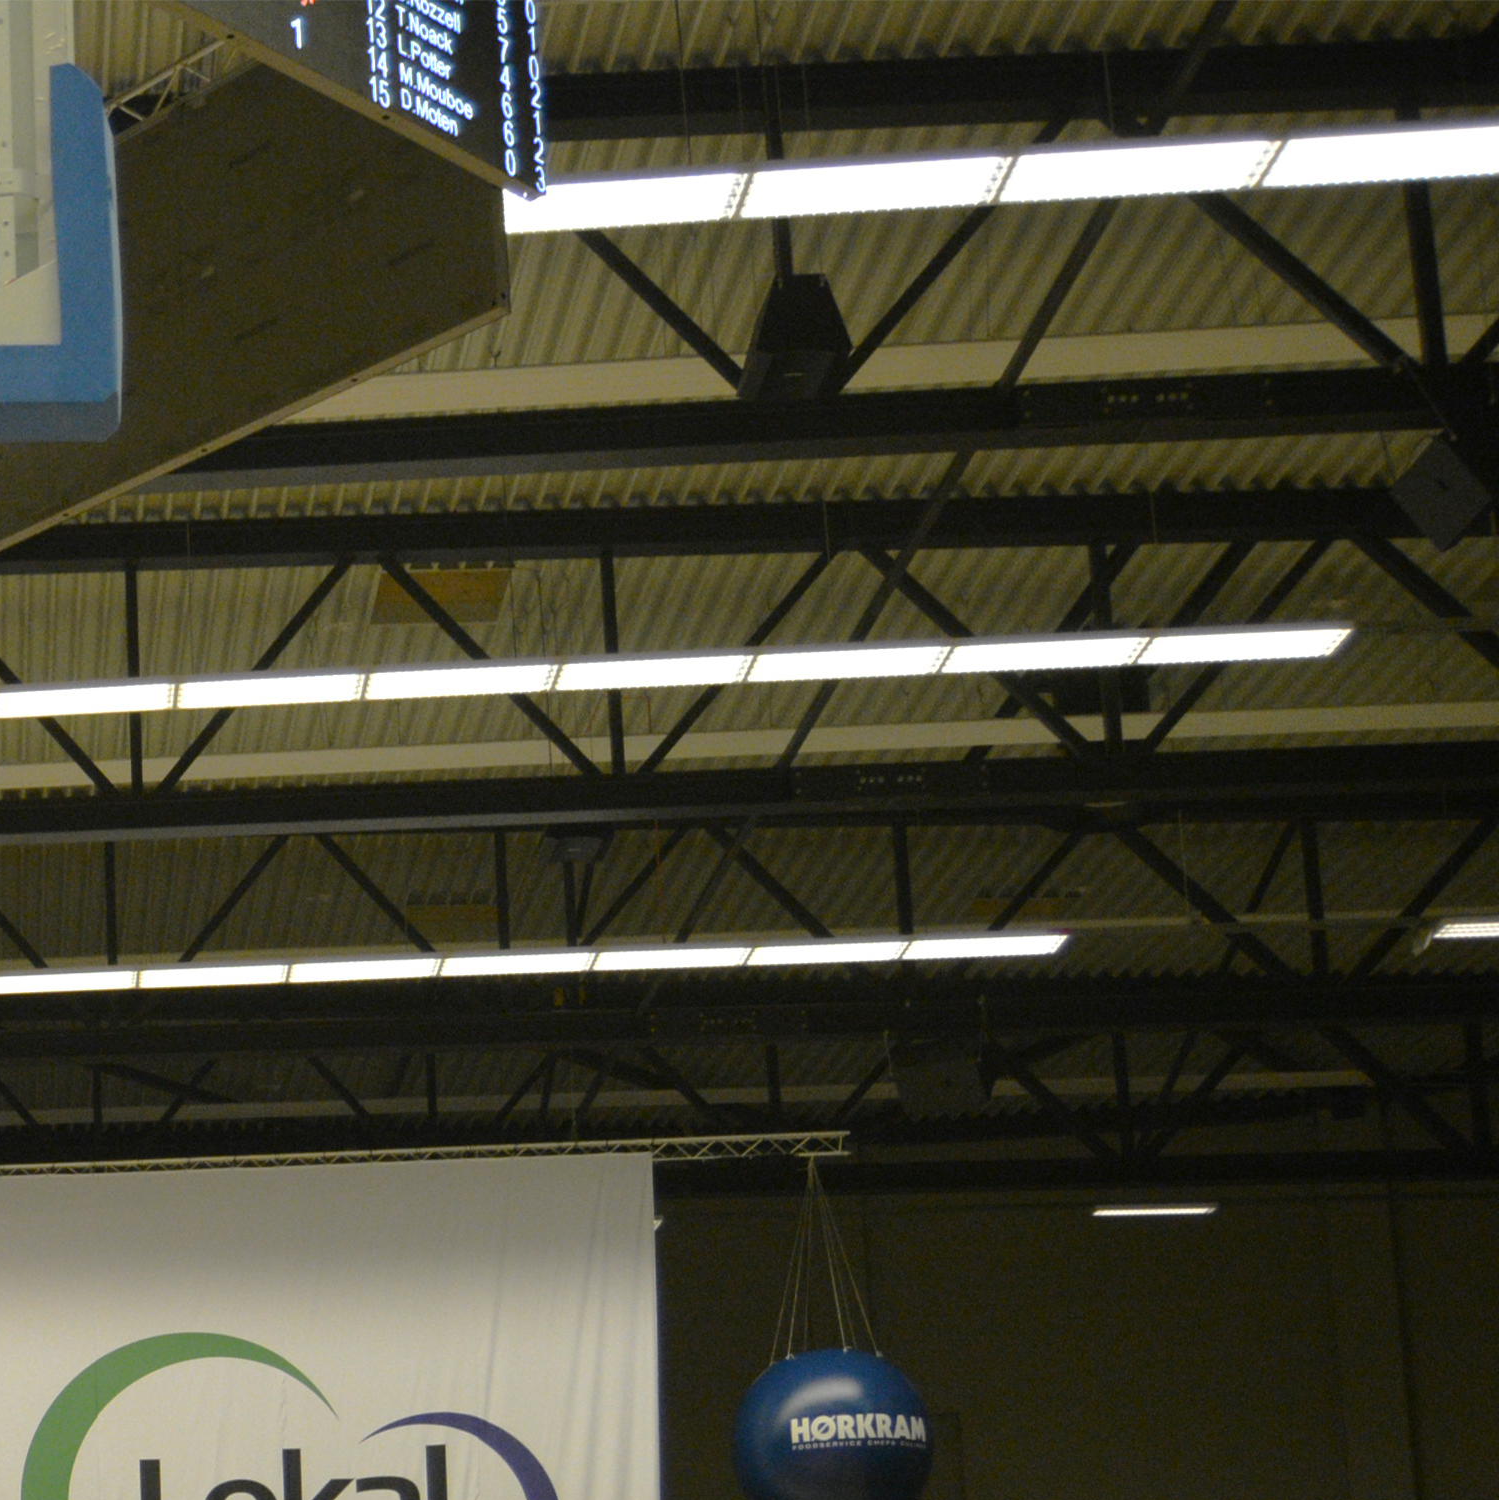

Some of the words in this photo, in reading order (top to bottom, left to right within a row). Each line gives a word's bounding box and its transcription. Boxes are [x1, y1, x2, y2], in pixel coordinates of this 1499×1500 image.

[366, 17, 388, 49] 13
[397, 33, 452, 80] L.Potter
[501, 92, 513, 119] 6
[533, 110, 542, 136] 1
[395, 4, 453, 55] T.Noack
[499, 65, 511, 92] 4
[530, 82, 542, 109] 2
[497, 7, 508, 34] 5
[527, 26, 536, 52] 1
[498, 36, 509, 64] 7
[528, 55, 540, 82] 0
[367, 46, 389, 79] 14
[502, 120, 515, 148] 6
[533, 137, 545, 165] 2
[369, 75, 391, 109] 15
[400, 88, 459, 137] D.Moten
[505, 149, 517, 177] 0
[535, 165, 547, 193] 3
[790, 1412, 926, 1444] HØRKRAM
